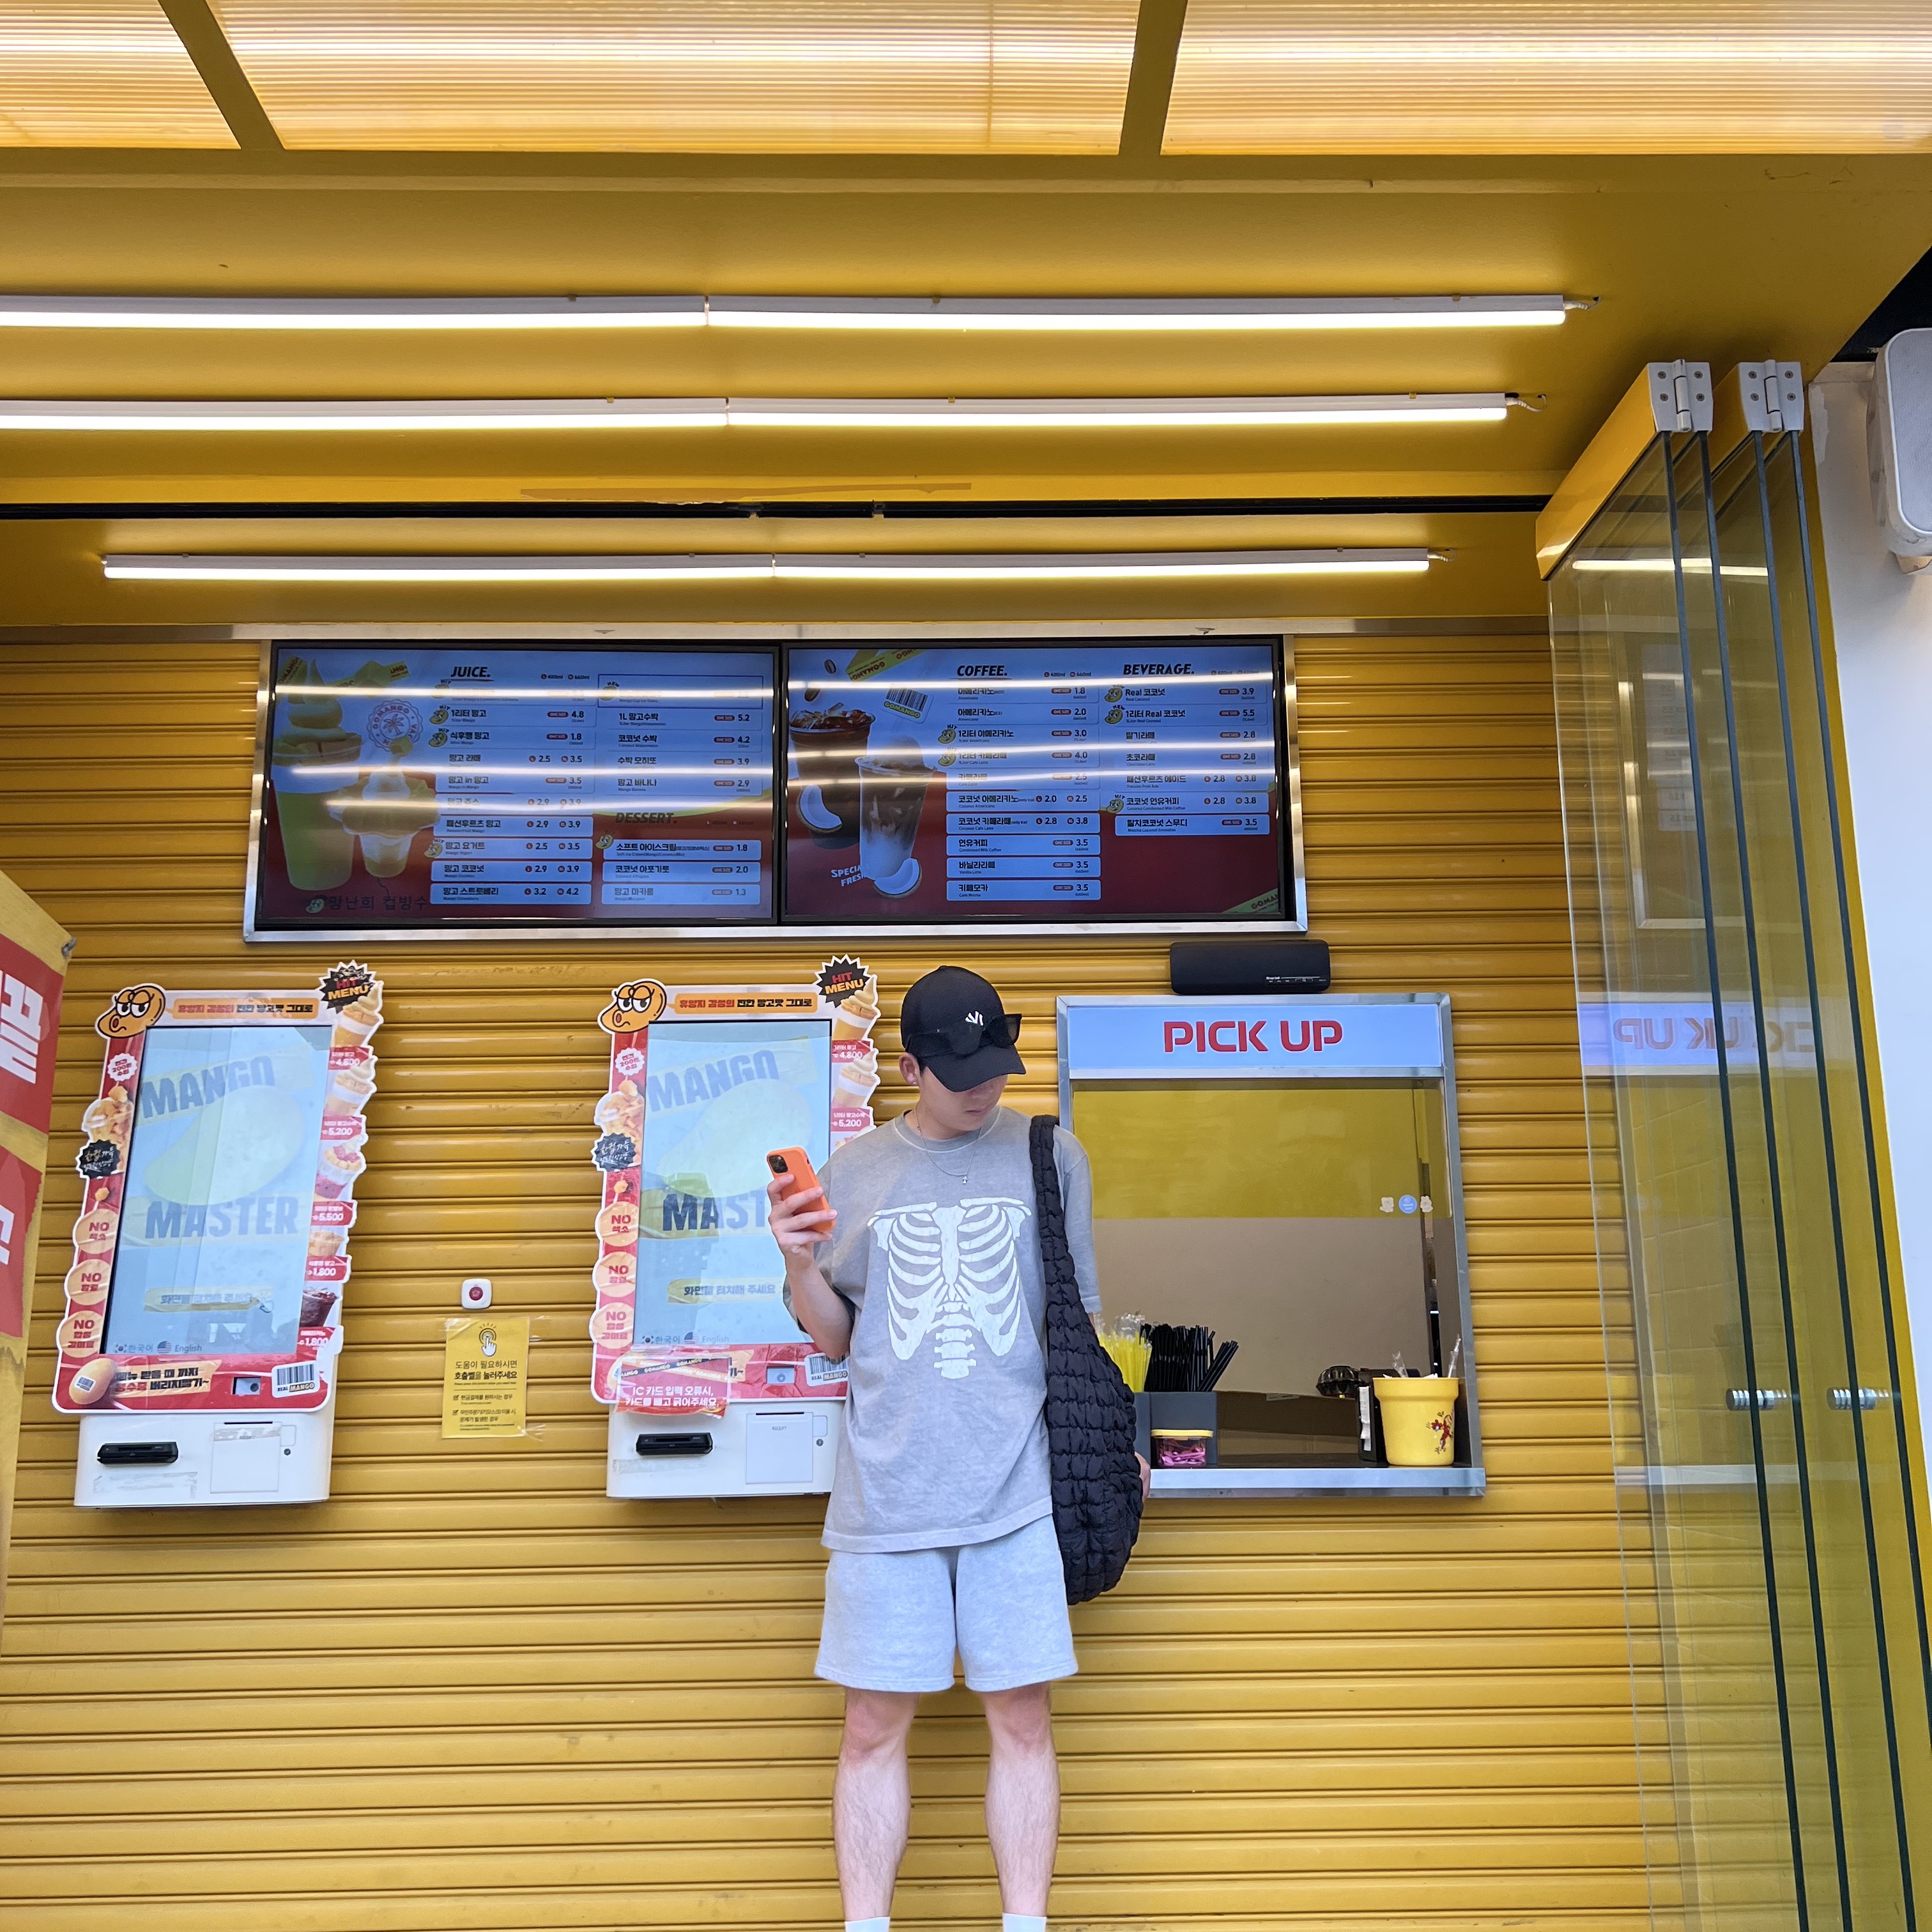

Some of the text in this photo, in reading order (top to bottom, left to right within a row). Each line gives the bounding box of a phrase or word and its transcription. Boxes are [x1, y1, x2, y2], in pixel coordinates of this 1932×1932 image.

[450, 666, 491, 678] JUICE.
[957, 665, 1008, 677] COFFEE.
[1123, 663, 1195, 675] BEVERAGE.
[884, 702, 921, 718] GOMANGO
[615, 812, 677, 824] DESSERT.
[640, 865, 670, 873] 아포가토
[832, 972, 853, 983] HIT
[825, 978, 864, 995] MENU
[328, 985, 369, 1000] MENU
[757, 999, 784, 1007] 망고맛
[786, 998, 812, 1007] 그대로
[1163, 1020, 1343, 1053] PICK UP
[839, 1051, 862, 1059] 4,800
[335, 1058, 360, 1066] 4,800
[647, 1049, 779, 1112] MANGO
[141, 1055, 275, 1119] MANGO
[838, 1119, 861, 1127] 5,200
[328, 1127, 353, 1136] 5,200
[663, 1189, 767, 1232] MAST
[144, 1196, 299, 1239] MASTER
[611, 1215, 631, 1224] NO
[89, 1222, 109, 1232] NO
[608, 1265, 629, 1275] NO
[81, 1273, 102, 1282] NO
[684, 1284, 776, 1296] 화면을 터치해 주세요
[606, 1312, 627, 1321] NO
[73, 1319, 95, 1330] NO
[655, 1335, 680, 1344] 한국어
[702, 1335, 729, 1344] English
[128, 1344, 153, 1353] 한국어
[175, 1344, 203, 1354] English
[456, 1360, 518, 1369] 도움이 필요하시면
[644, 1358, 702, 1373] GOMANGO GOMANGO
[454, 1371, 518, 1380] 호출벨을 눌러주세요
[823, 1370, 848, 1381] MANGO
[289, 1382, 316, 1392] MANGO
[632, 1386, 644, 1396] IC
[646, 1386, 663, 1396] 카드
[666, 1386, 683, 1396] 입력
[625, 1397, 651, 1406] 카드를
